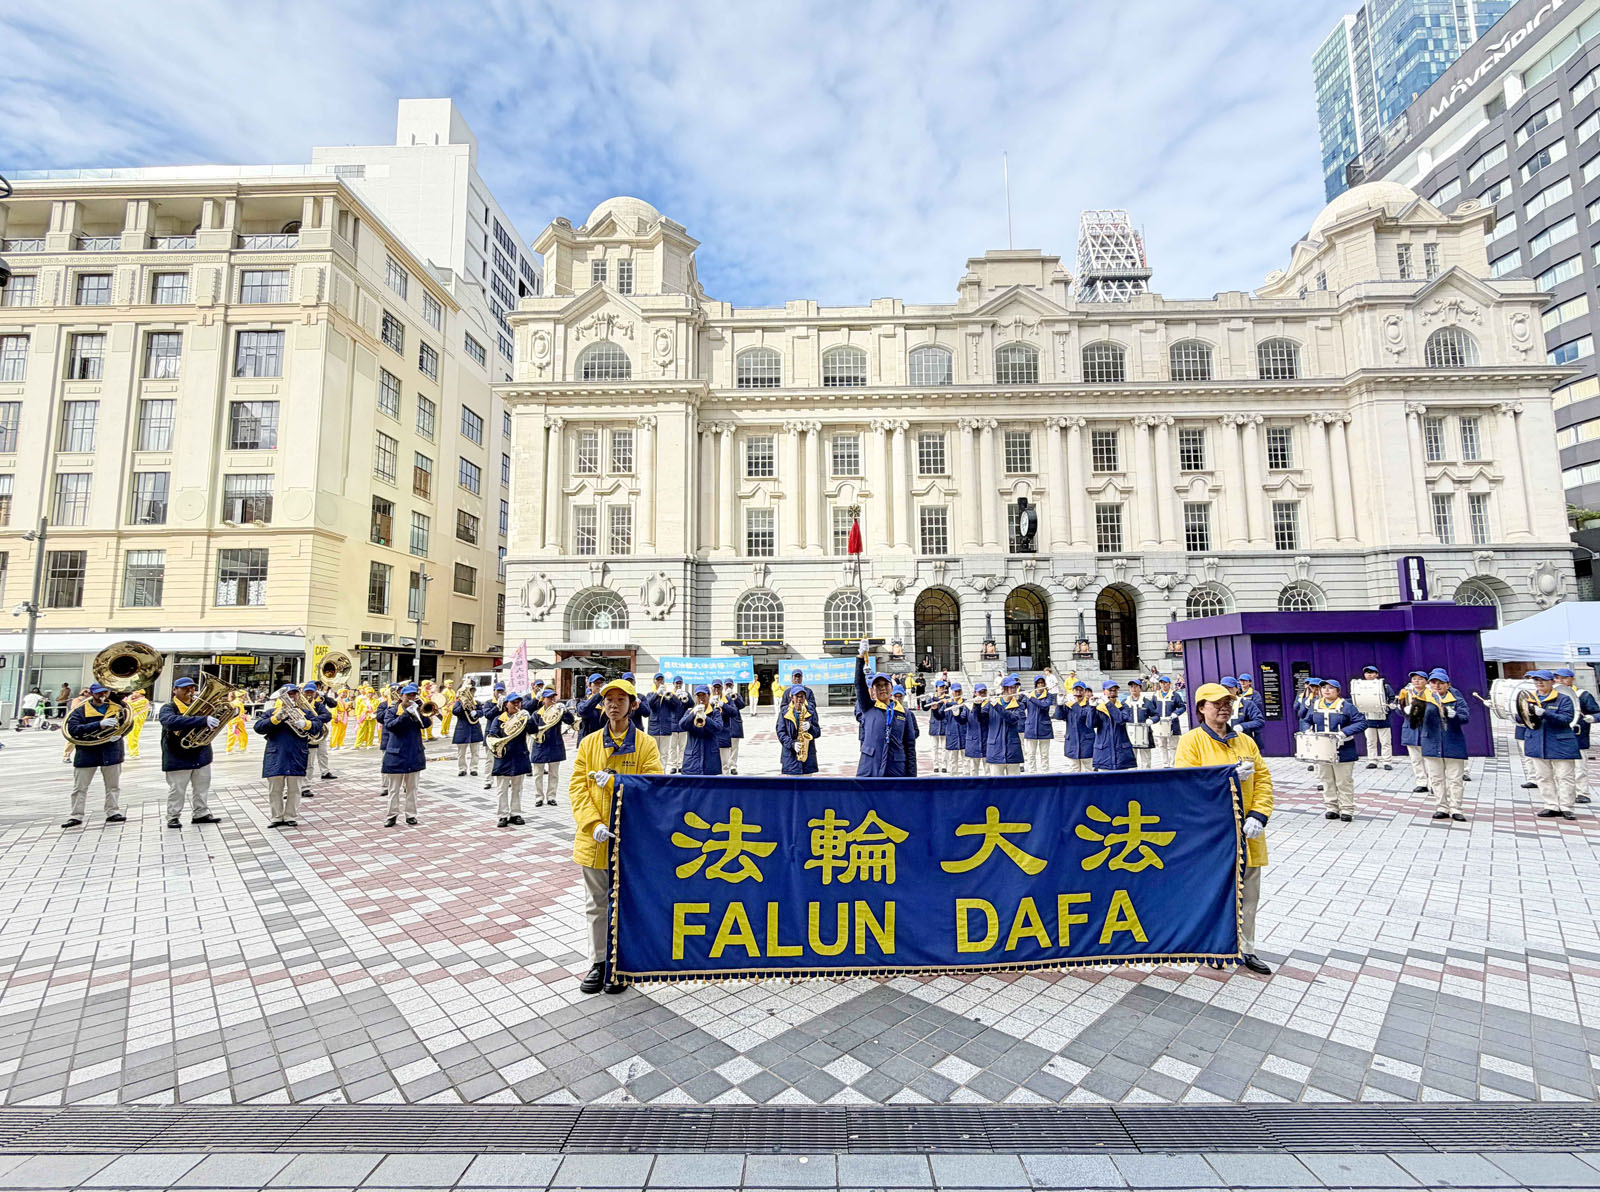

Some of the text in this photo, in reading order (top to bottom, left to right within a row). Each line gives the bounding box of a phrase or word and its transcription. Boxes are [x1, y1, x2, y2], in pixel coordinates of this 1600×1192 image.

[670, 799, 1177, 886] 法輪大法
[671, 889, 1149, 961] FALUN DAFA
